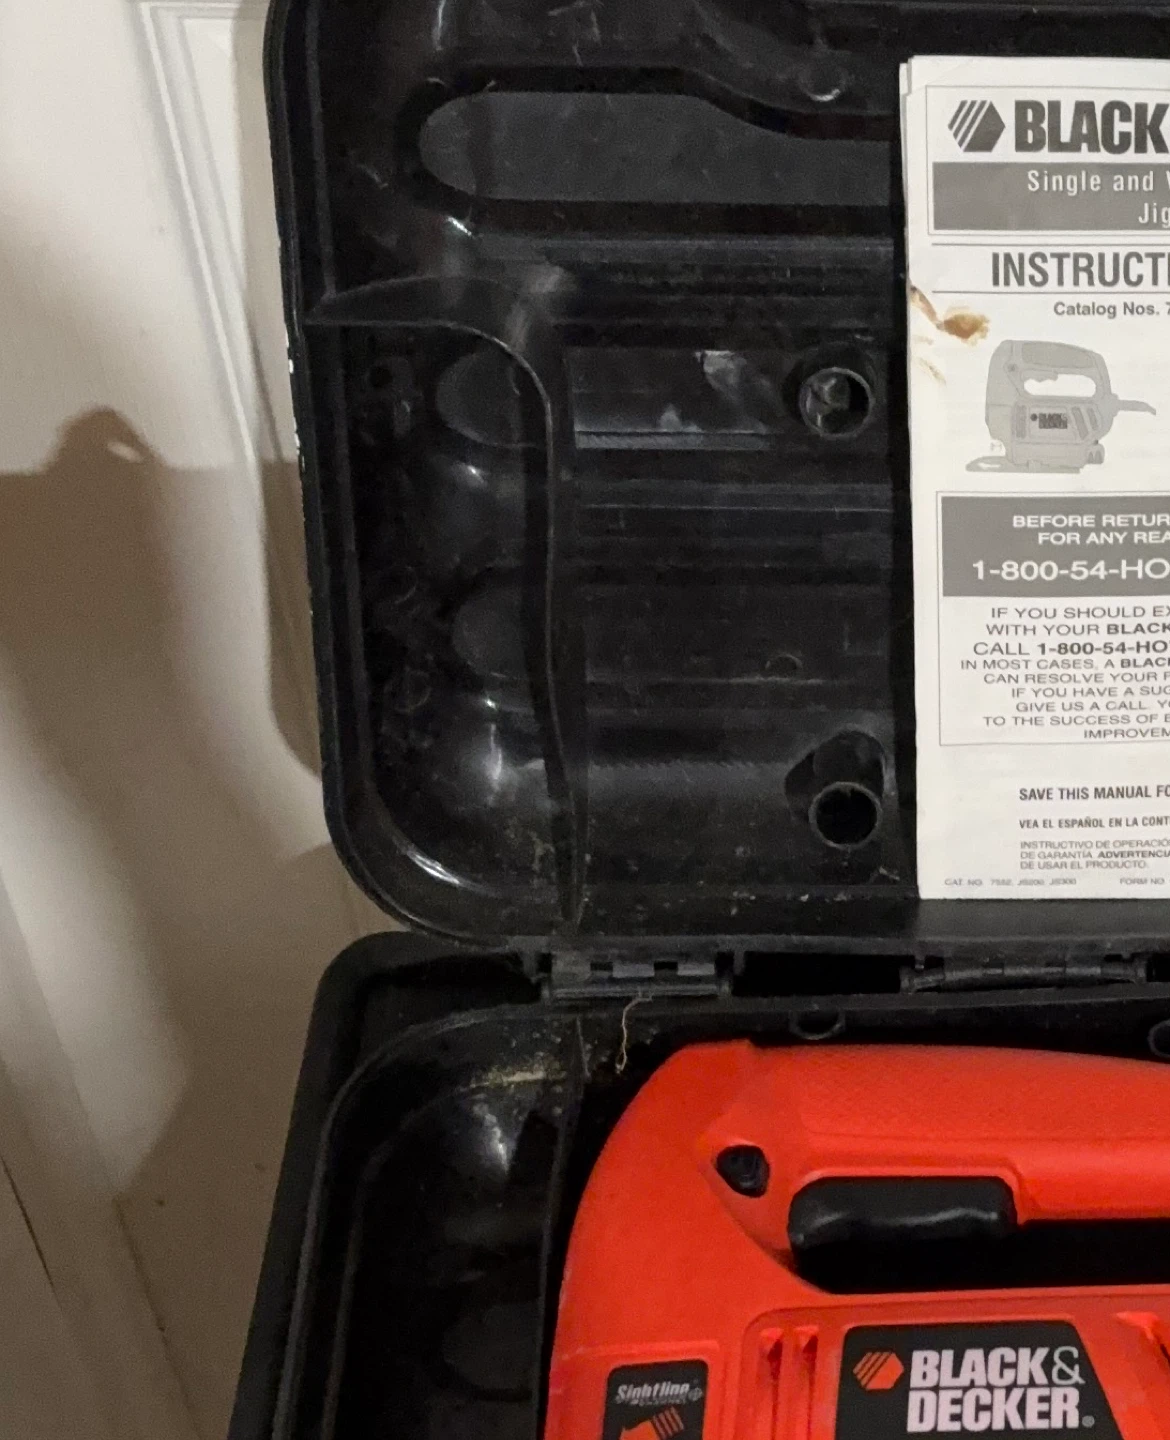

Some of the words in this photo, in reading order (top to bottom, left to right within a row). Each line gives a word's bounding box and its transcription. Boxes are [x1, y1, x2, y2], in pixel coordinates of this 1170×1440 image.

[1027, 170, 1101, 196] Single
[1113, 171, 1153, 191] and
[1054, 302, 1117, 318] Catalog
[1124, 302, 1159, 316] Nos.
[1013, 515, 1095, 528] BEFORE
[1038, 532, 1080, 545] FOR
[1086, 532, 1128, 544] ANY
[991, 608, 1007, 619] IF
[1014, 607, 1057, 619] YOU
[1064, 607, 1145, 618] SHOULD
[986, 624, 1036, 636] WITH
[1043, 624, 1099, 635] YOUR
[973, 642, 1030, 655] CALL
[961, 660, 976, 670] IN
[983, 660, 1030, 669] MOST
[1104, 659, 1115, 668] A
[984, 673, 1019, 684] CAN
[1025, 673, 1104, 684] RESOLVE
[1110, 672, 1158, 683] YOUR
[1012, 688, 1025, 698] IF
[1032, 688, 1067, 697] YOU
[1073, 687, 1118, 697] HAVE
[1123, 687, 1134, 696] A
[1016, 702, 1055, 712] GIVE
[1062, 701, 1084, 712] US
[1090, 701, 1100, 711] A
[983, 716, 1006, 726] TO
[1012, 715, 1044, 726] THE
[1050, 714, 1131, 726] SUCCESS
[1136, 713, 1158, 724] OF
[1019, 788, 1053, 801] SAVE
[1058, 787, 1089, 800] THIS
[1094, 786, 1151, 799] MANUAL
[1019, 819, 1038, 829] VEA
[1043, 819, 1054, 828] EL
[1058, 816, 1105, 828] ESPAÑOL
[1109, 818, 1122, 827] EN
[1126, 818, 1138, 827] LA
[1020, 840, 1093, 850] INSTRUCTIVO
[1096, 840, 1110, 849] DE
[1020, 851, 1035, 859] DE
[1020, 861, 1035, 870] DE
[1038, 861, 1068, 869] USAR
[1070, 860, 1083, 869] EL
[907, 1387, 1080, 1433] DECKER
